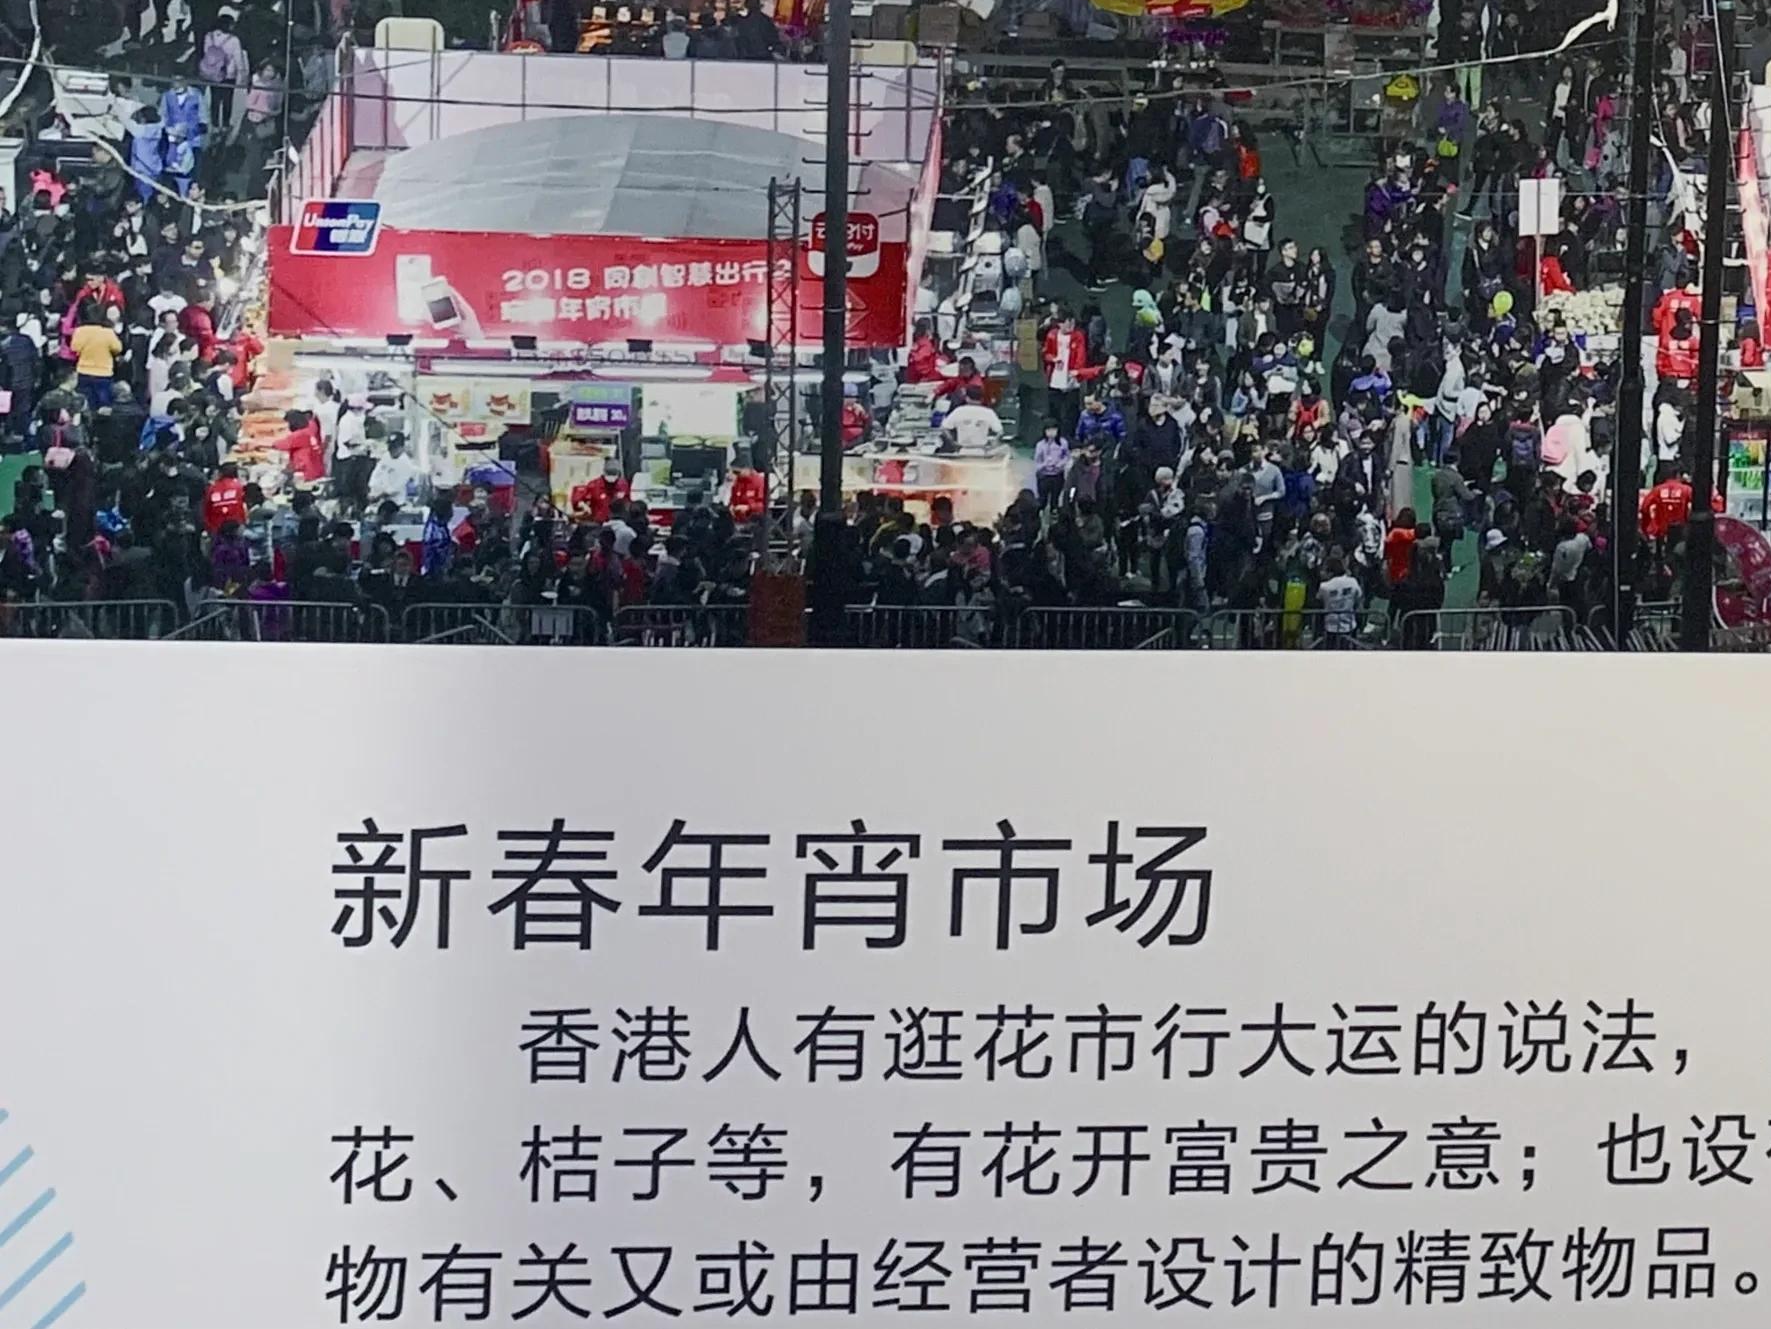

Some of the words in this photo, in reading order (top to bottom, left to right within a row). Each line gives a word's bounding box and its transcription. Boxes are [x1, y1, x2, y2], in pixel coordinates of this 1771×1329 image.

[502, 268, 591, 293] 2018
[331, 817, 1212, 951] 新春年宵市场
[326, 1226, 1757, 1324] 物有关又或由经营者设计的精致物品。
